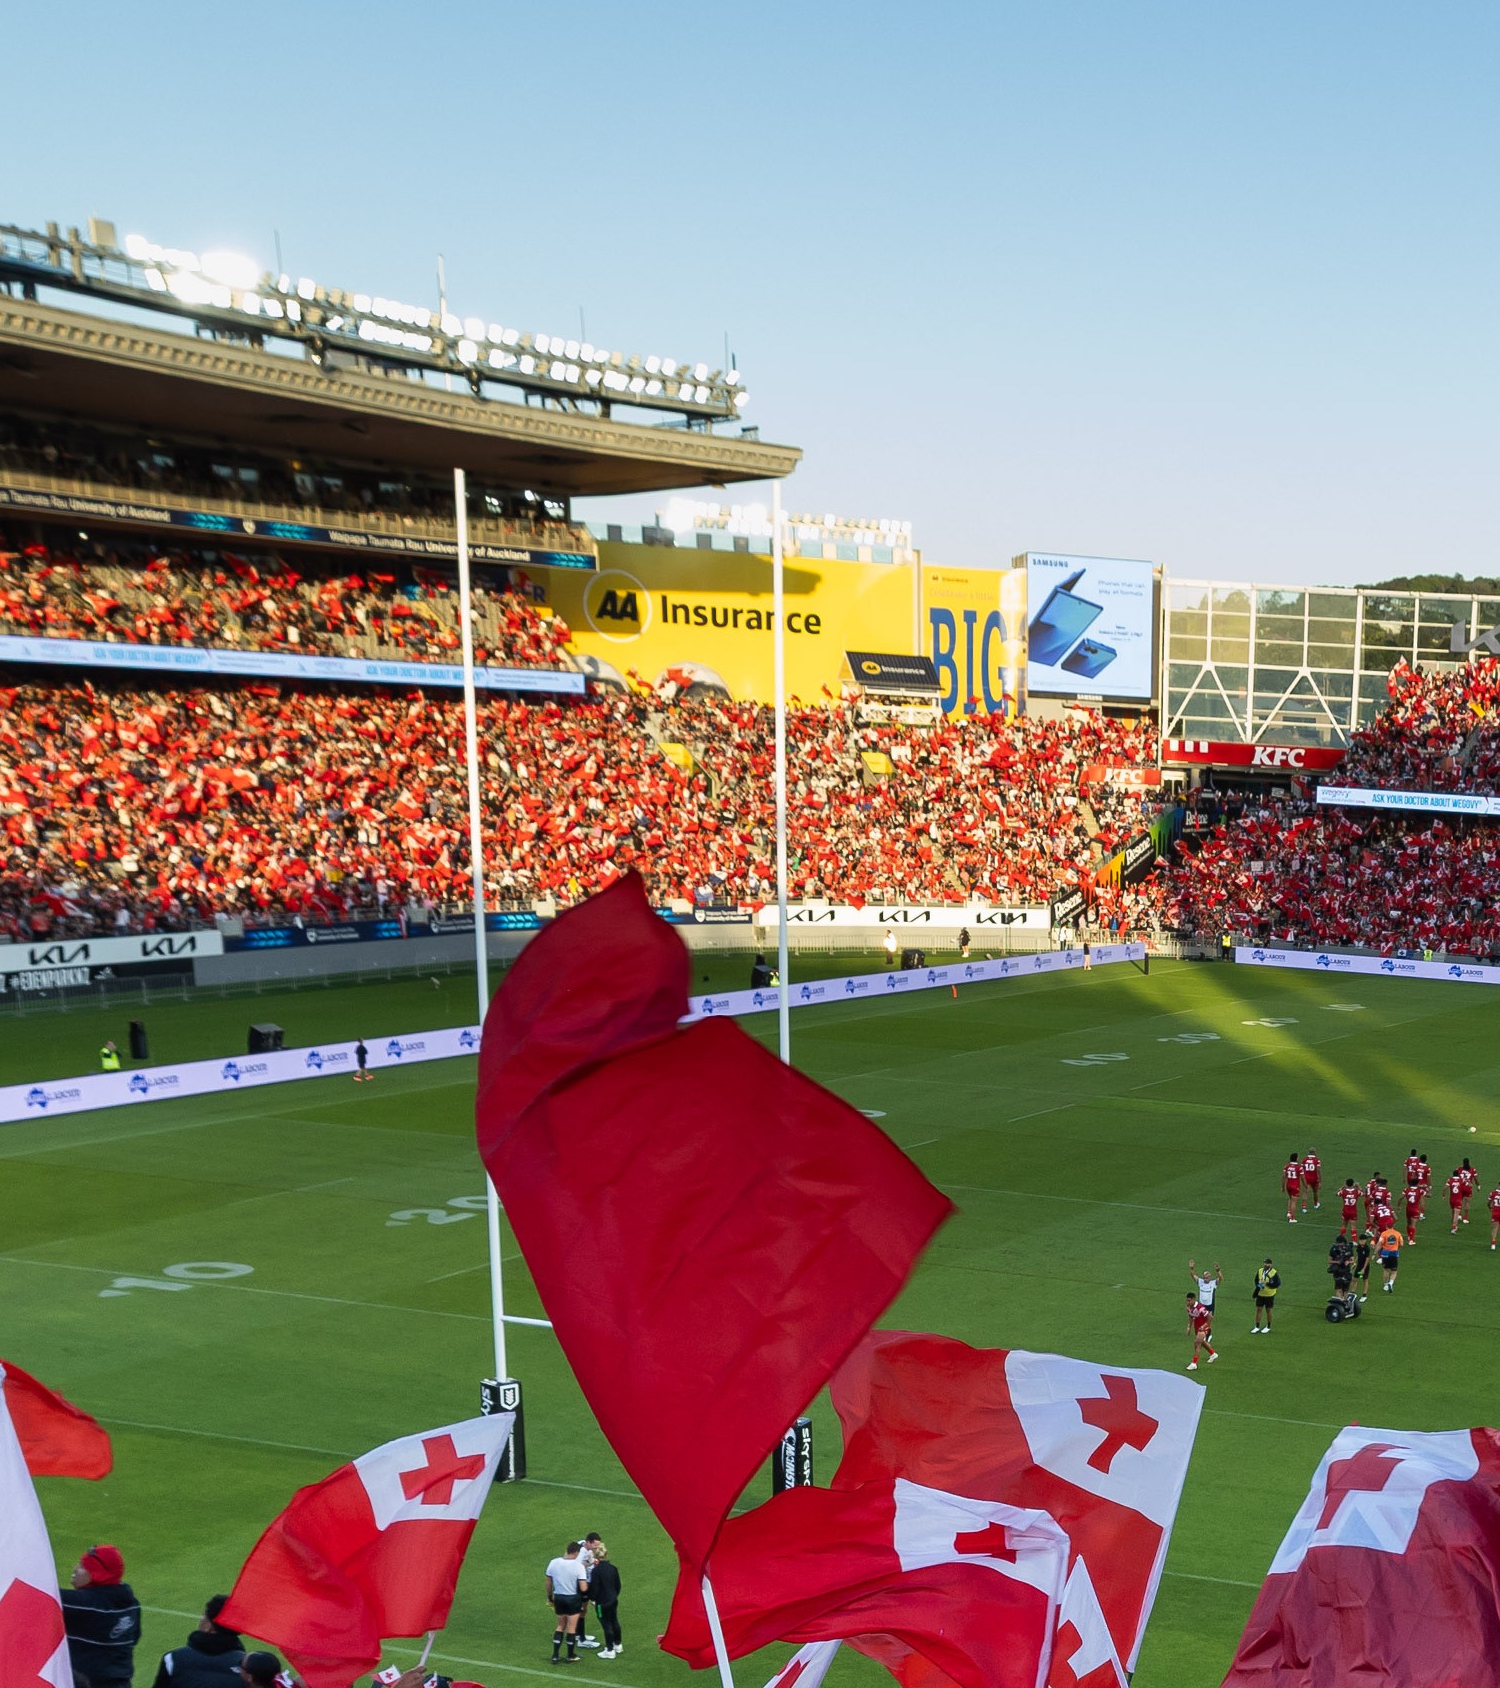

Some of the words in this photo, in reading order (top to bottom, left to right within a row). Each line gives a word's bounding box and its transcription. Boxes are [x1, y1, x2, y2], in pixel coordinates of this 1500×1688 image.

[8, 488, 48, 507] Taumata
[49, 494, 68, 509] Rau
[70, 496, 114, 517] University
[115, 503, 127, 516] of
[129, 506, 170, 522] Auckland
[329, 530, 363, 547] Waipapa
[364, 532, 400, 549] Taumata
[405, 537, 424, 551] Rau
[474, 547, 484, 559] of
[486, 546, 530, 562] Auckland
[1033, 558, 1068, 568] SAMSUNG
[596, 590, 639, 621] AA
[661, 594, 822, 635] Insurance
[881, 663, 927, 677] Insurance
[1252, 746, 1305, 767] KFC
[1105, 768, 1143, 783] KFC
[1321, 788, 1350, 798] wegovy
[1372, 794, 1385, 804] ASK
[1387, 795, 1403, 805] YOUR
[1404, 796, 1429, 806] DOCTOR
[1430, 797, 1451, 807] ABOUT
[1264, 953, 1286, 961] LABOUR
[1329, 958, 1351, 966] LABOUR
[1393, 963, 1416, 972] LABOUR
[1460, 968, 1483, 977] LABOUR
[108, 1260, 253, 1294] 10
